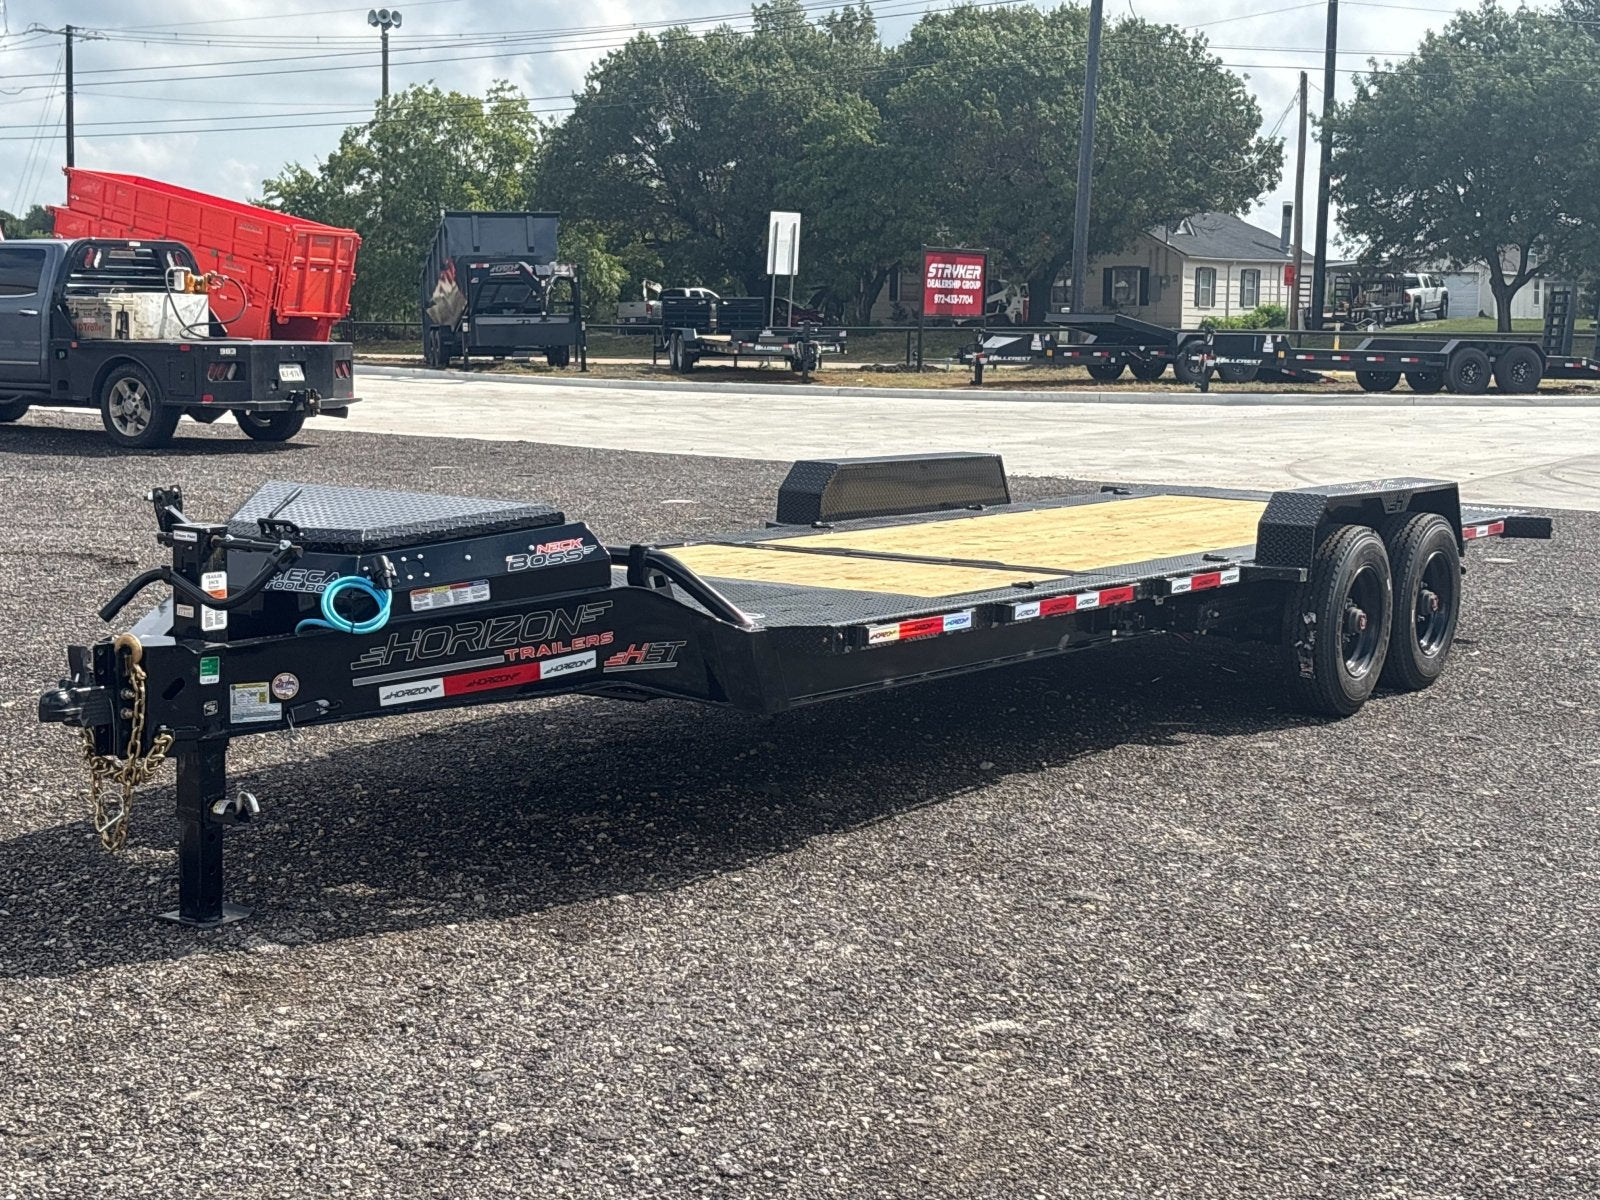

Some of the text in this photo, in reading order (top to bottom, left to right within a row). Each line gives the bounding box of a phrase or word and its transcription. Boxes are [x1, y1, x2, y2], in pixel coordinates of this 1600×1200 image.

[927, 263, 982, 279] STRYKER
[927, 279, 981, 290] DEALERSHIP GROUP
[934, 294, 973, 304] 972-433-7704
[1215, 357, 1263, 365] HILLCREST
[536, 538, 584, 555] NECK
[506, 548, 585, 572] BOSS
[265, 581, 330, 594] TOOLBO
[376, 604, 592, 666] HORIZON
[503, 631, 614, 662] TRAILERS
[547, 658, 591, 675] HORIZON
[469, 672, 518, 688] HORIZON
[386, 684, 438, 701] HORIZON
